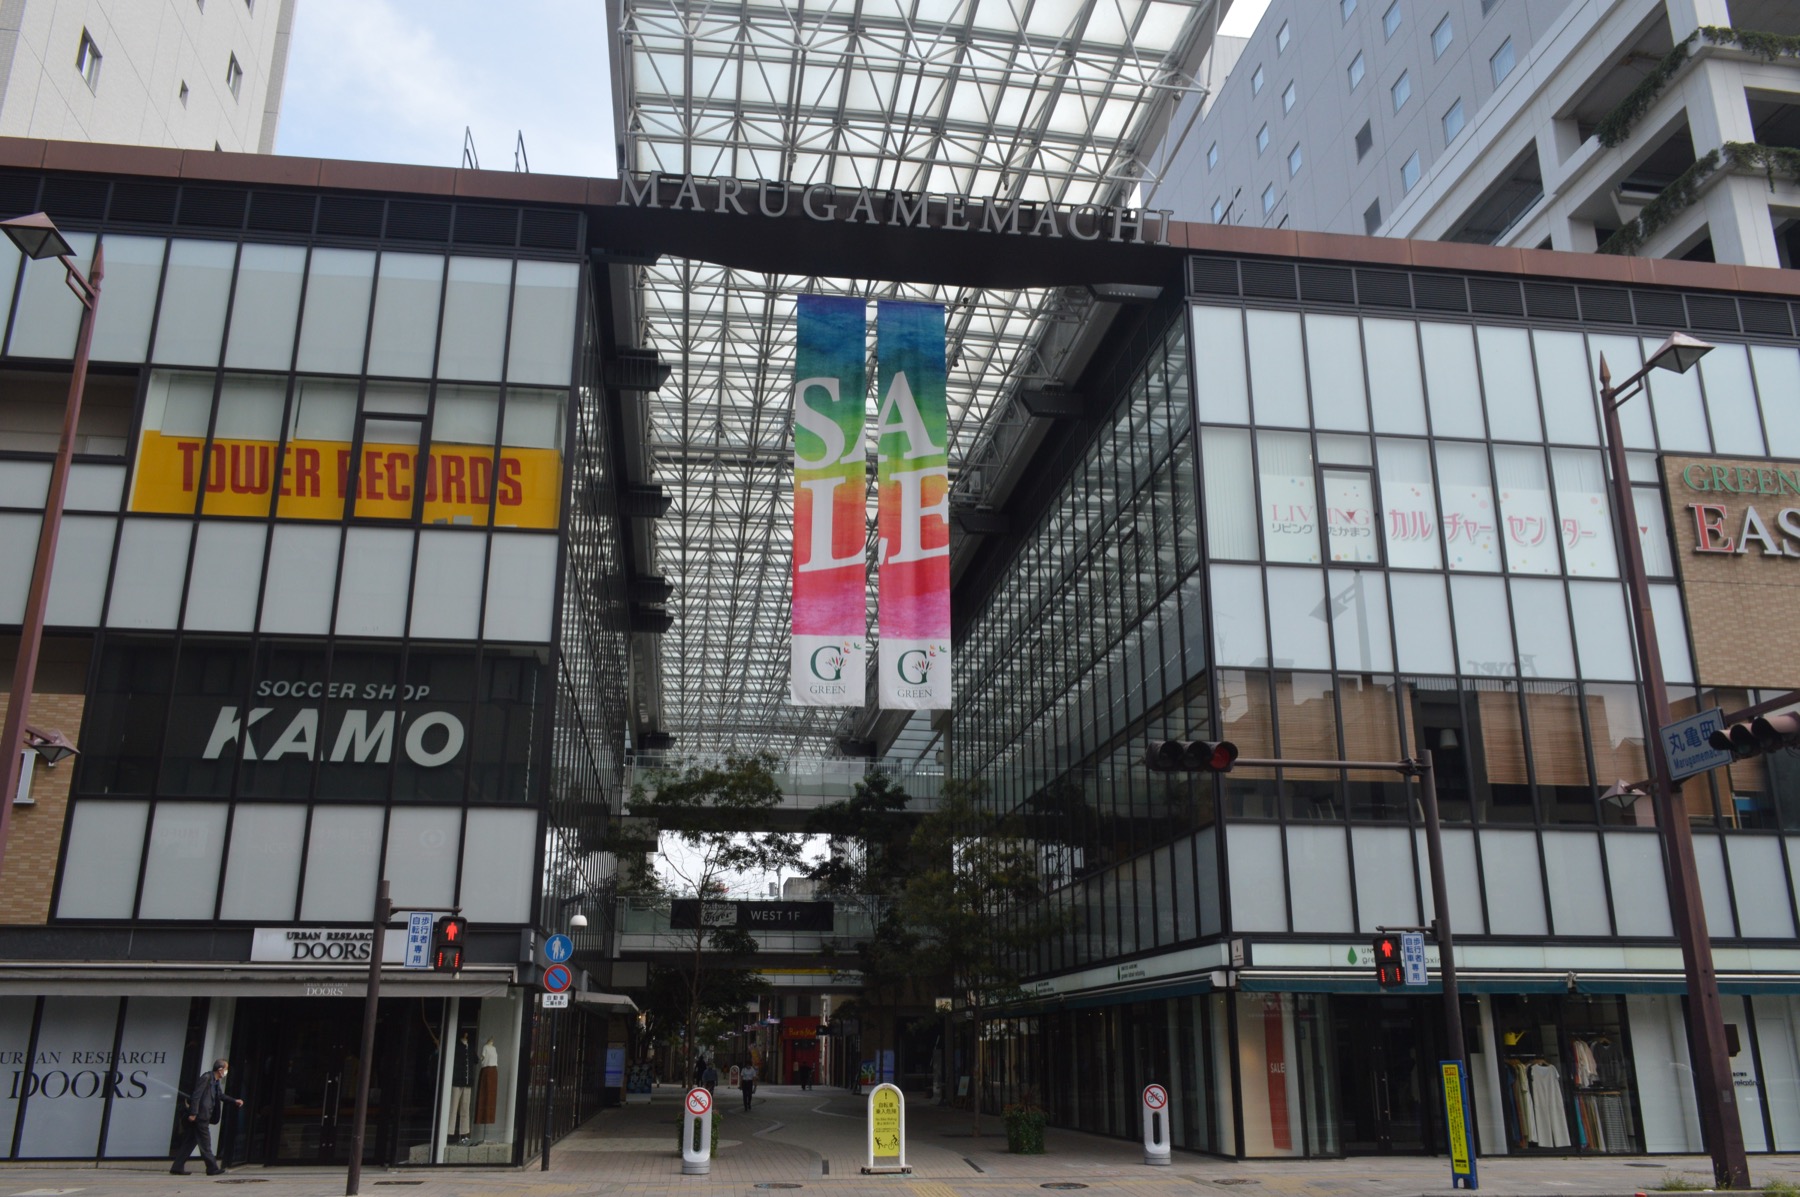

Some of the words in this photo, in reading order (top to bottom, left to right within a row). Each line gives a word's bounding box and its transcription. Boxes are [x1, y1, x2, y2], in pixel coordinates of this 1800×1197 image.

[616, 168, 1174, 246] MARUGAMEMACHI
[177, 441, 320, 498] TOWER
[338, 449, 522, 506] RECORDS
[1683, 463, 1800, 496] GREEN
[1272, 504, 1370, 526] LIVING
[1389, 508, 1595, 548] カルチャーセンター
[256, 680, 355, 698] SOCCER
[362, 683, 430, 700] SHOP
[810, 685, 846, 695] GREEN
[897, 688, 933, 698] GREEN
[202, 705, 465, 767] KAMO
[1669, 720, 1716, 755] 丸亀町
[751, 910, 783, 920] WEST
[787, 911, 801, 921] 1F
[286, 931, 321, 940] URBAN
[327, 932, 373, 940] RESEARC
[410, 916, 420, 943] 自転車
[420, 916, 430, 943] 歩行者
[292, 942, 371, 960] DOORS
[412, 945, 422, 963] 専用
[306, 987, 343, 996] DOORS
[0, 1052, 60, 1064] URAN
[1270, 1062, 1285, 1073] SALE
[9, 1070, 149, 1099] DOORS
